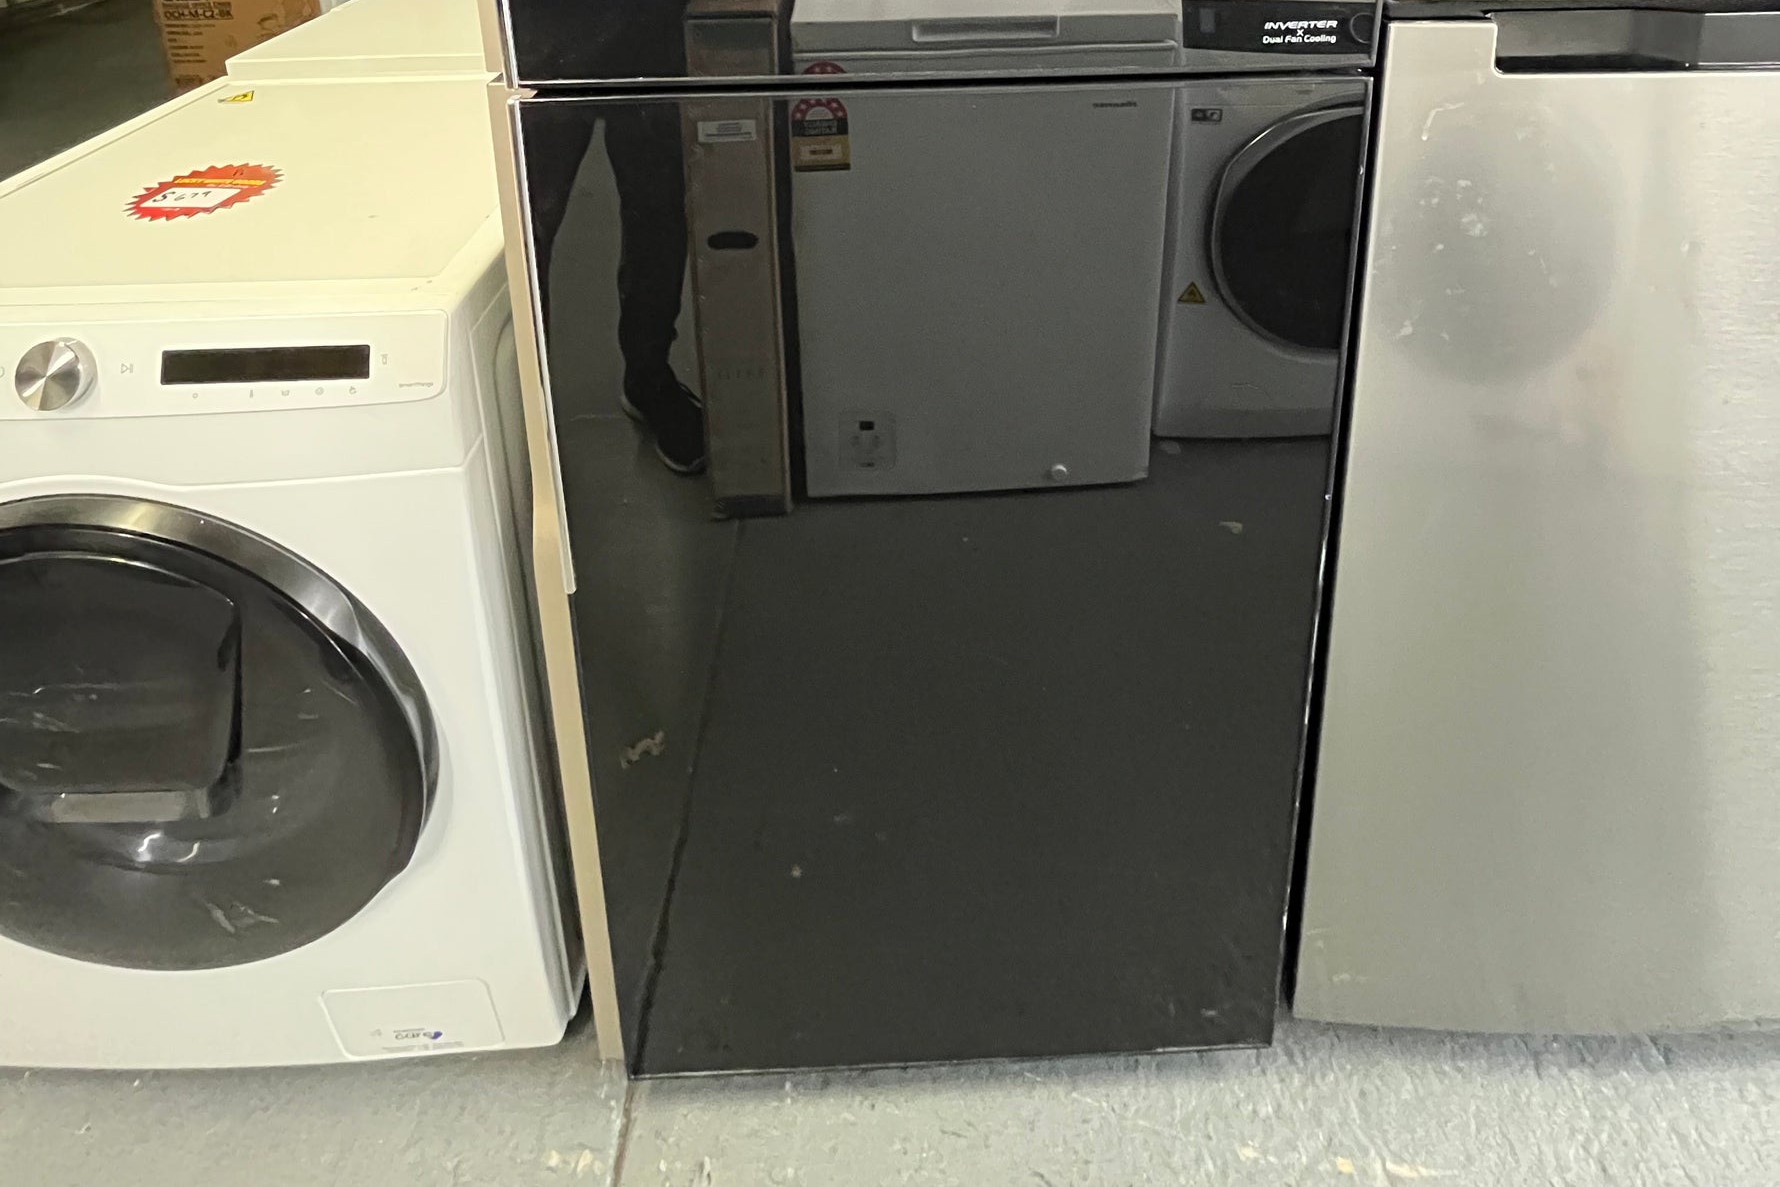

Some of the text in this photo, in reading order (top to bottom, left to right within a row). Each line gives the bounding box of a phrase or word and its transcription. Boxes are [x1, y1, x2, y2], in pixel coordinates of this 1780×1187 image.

[1263, 19, 1338, 31] INVERTER
[1262, 33, 1337, 44] Dual Fan Cooling
